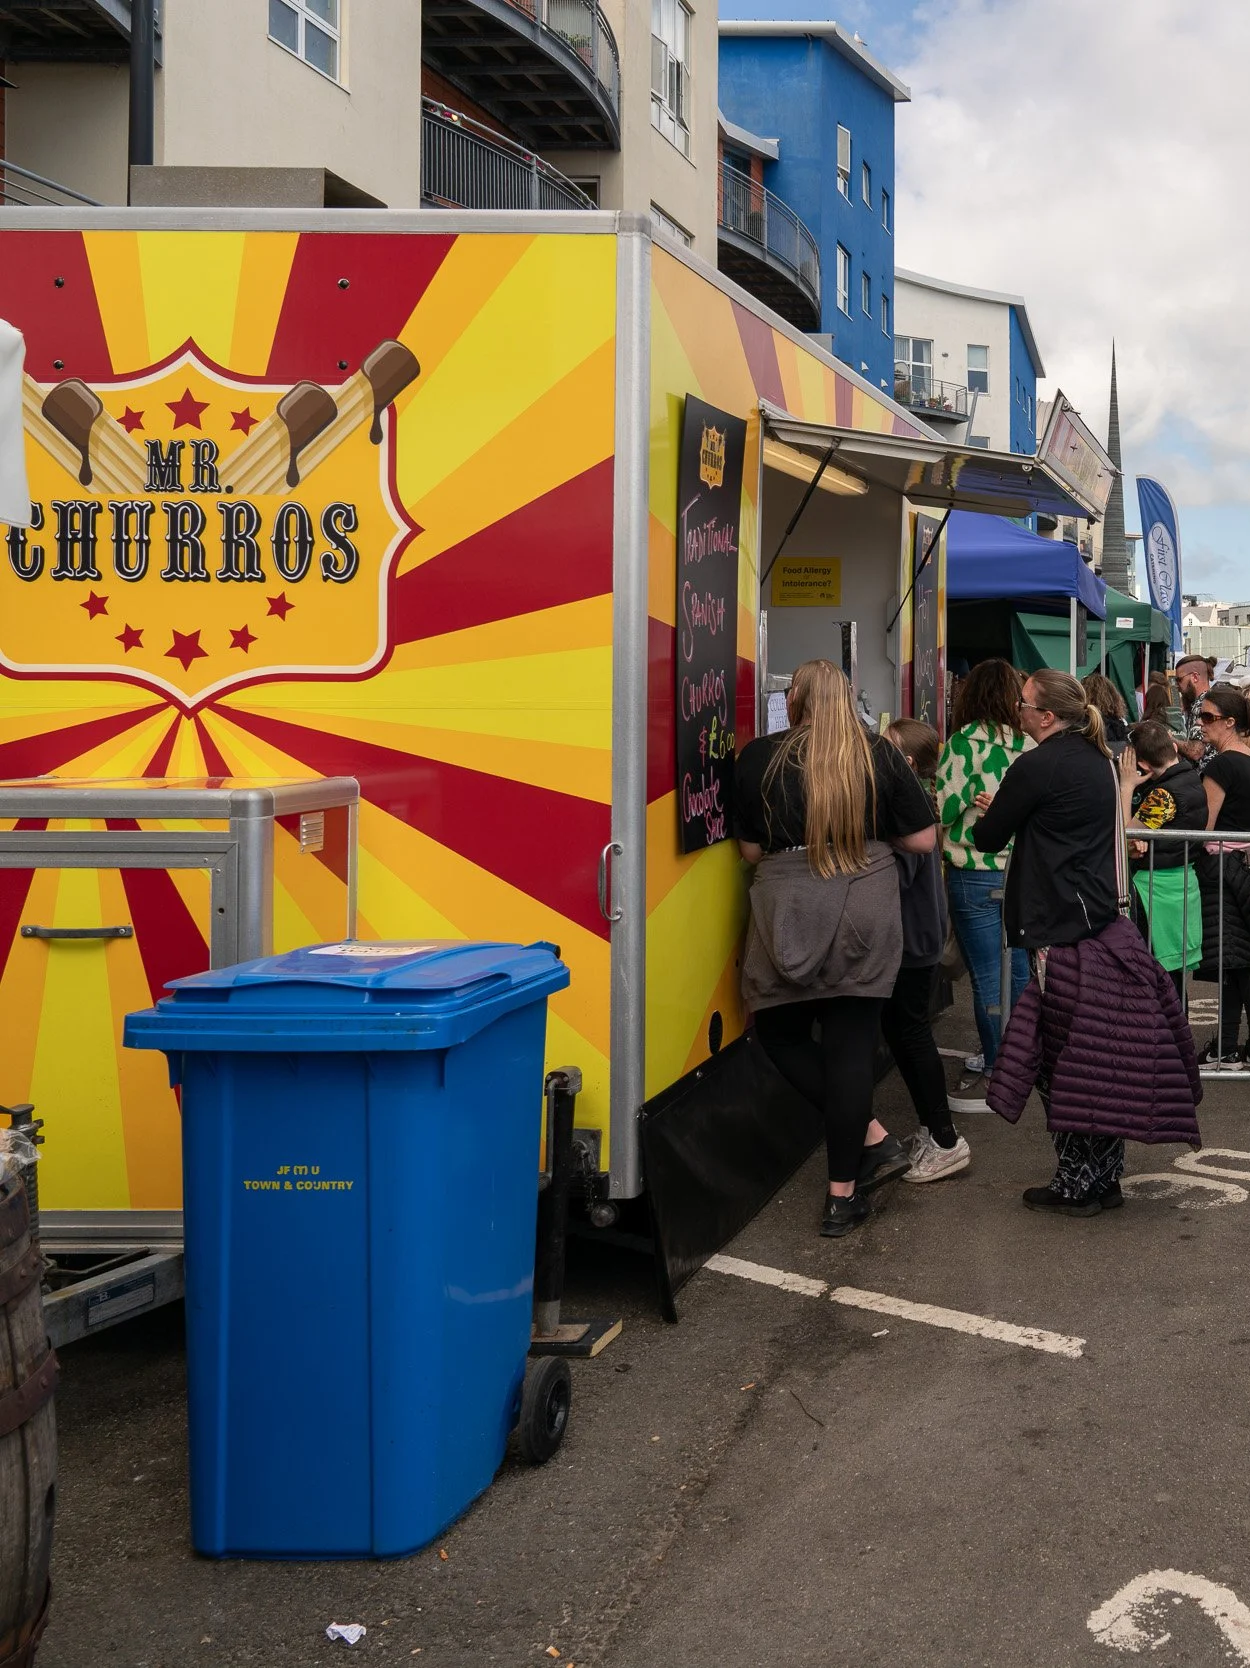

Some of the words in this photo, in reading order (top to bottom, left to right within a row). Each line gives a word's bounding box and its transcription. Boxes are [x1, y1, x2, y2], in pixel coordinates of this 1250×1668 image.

[144, 438, 234, 494] MR.
[6, 500, 360, 583] CHURROS
[682, 493, 738, 565] TRADITIONAL
[1152, 525, 1170, 566] First
[782, 566, 802, 574] Food
[803, 566, 832, 575] Allergy
[782, 579, 832, 587] Intolerance?
[681, 668, 728, 727] CHURROS
[244, 1181, 280, 1190] TOWN
[283, 1181, 293, 1190] &
[295, 1181, 354, 1190] COUNTRY
[277, 1165, 291, 1175] JF
[311, 1165, 320, 1175] U
